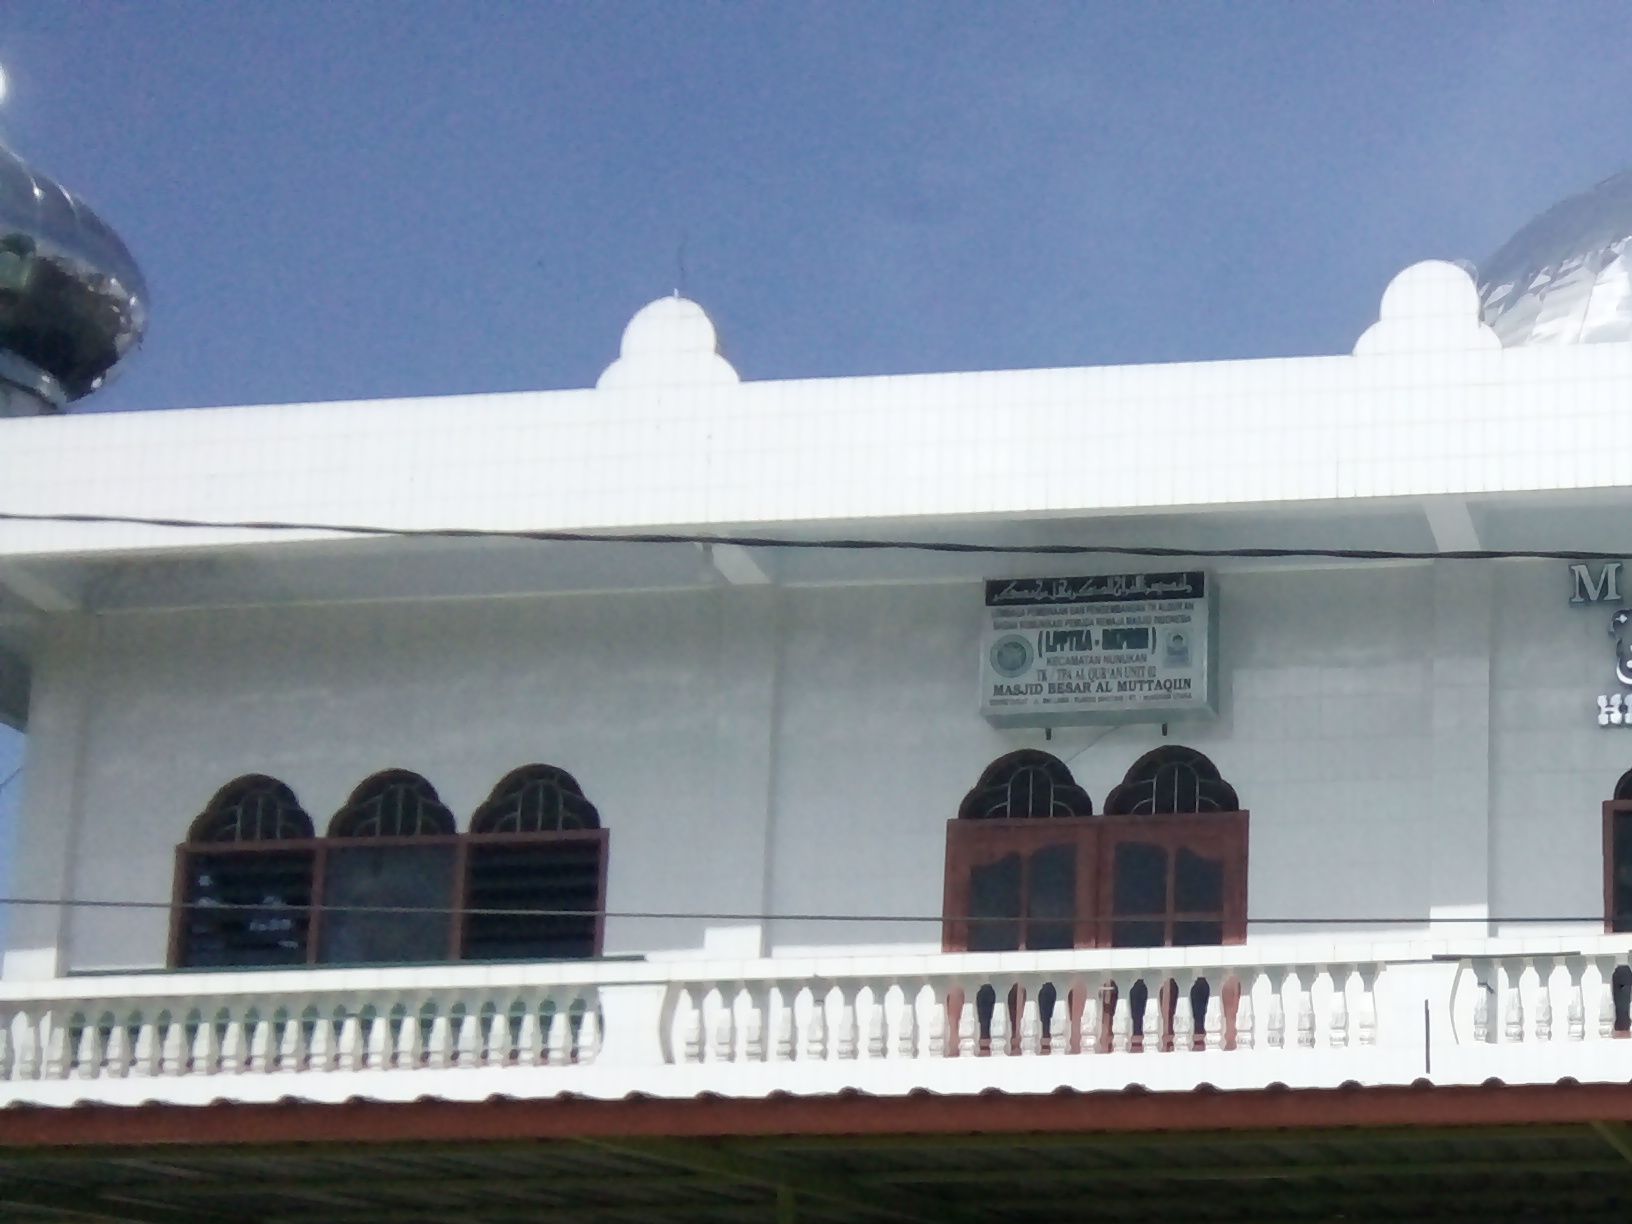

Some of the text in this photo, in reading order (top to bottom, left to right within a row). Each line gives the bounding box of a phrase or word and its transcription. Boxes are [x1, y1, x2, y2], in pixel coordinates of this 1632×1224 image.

[993, 683, 1043, 696] MASJID
[1048, 682, 1092, 694] BESAR
[1095, 681, 1113, 692] AL
